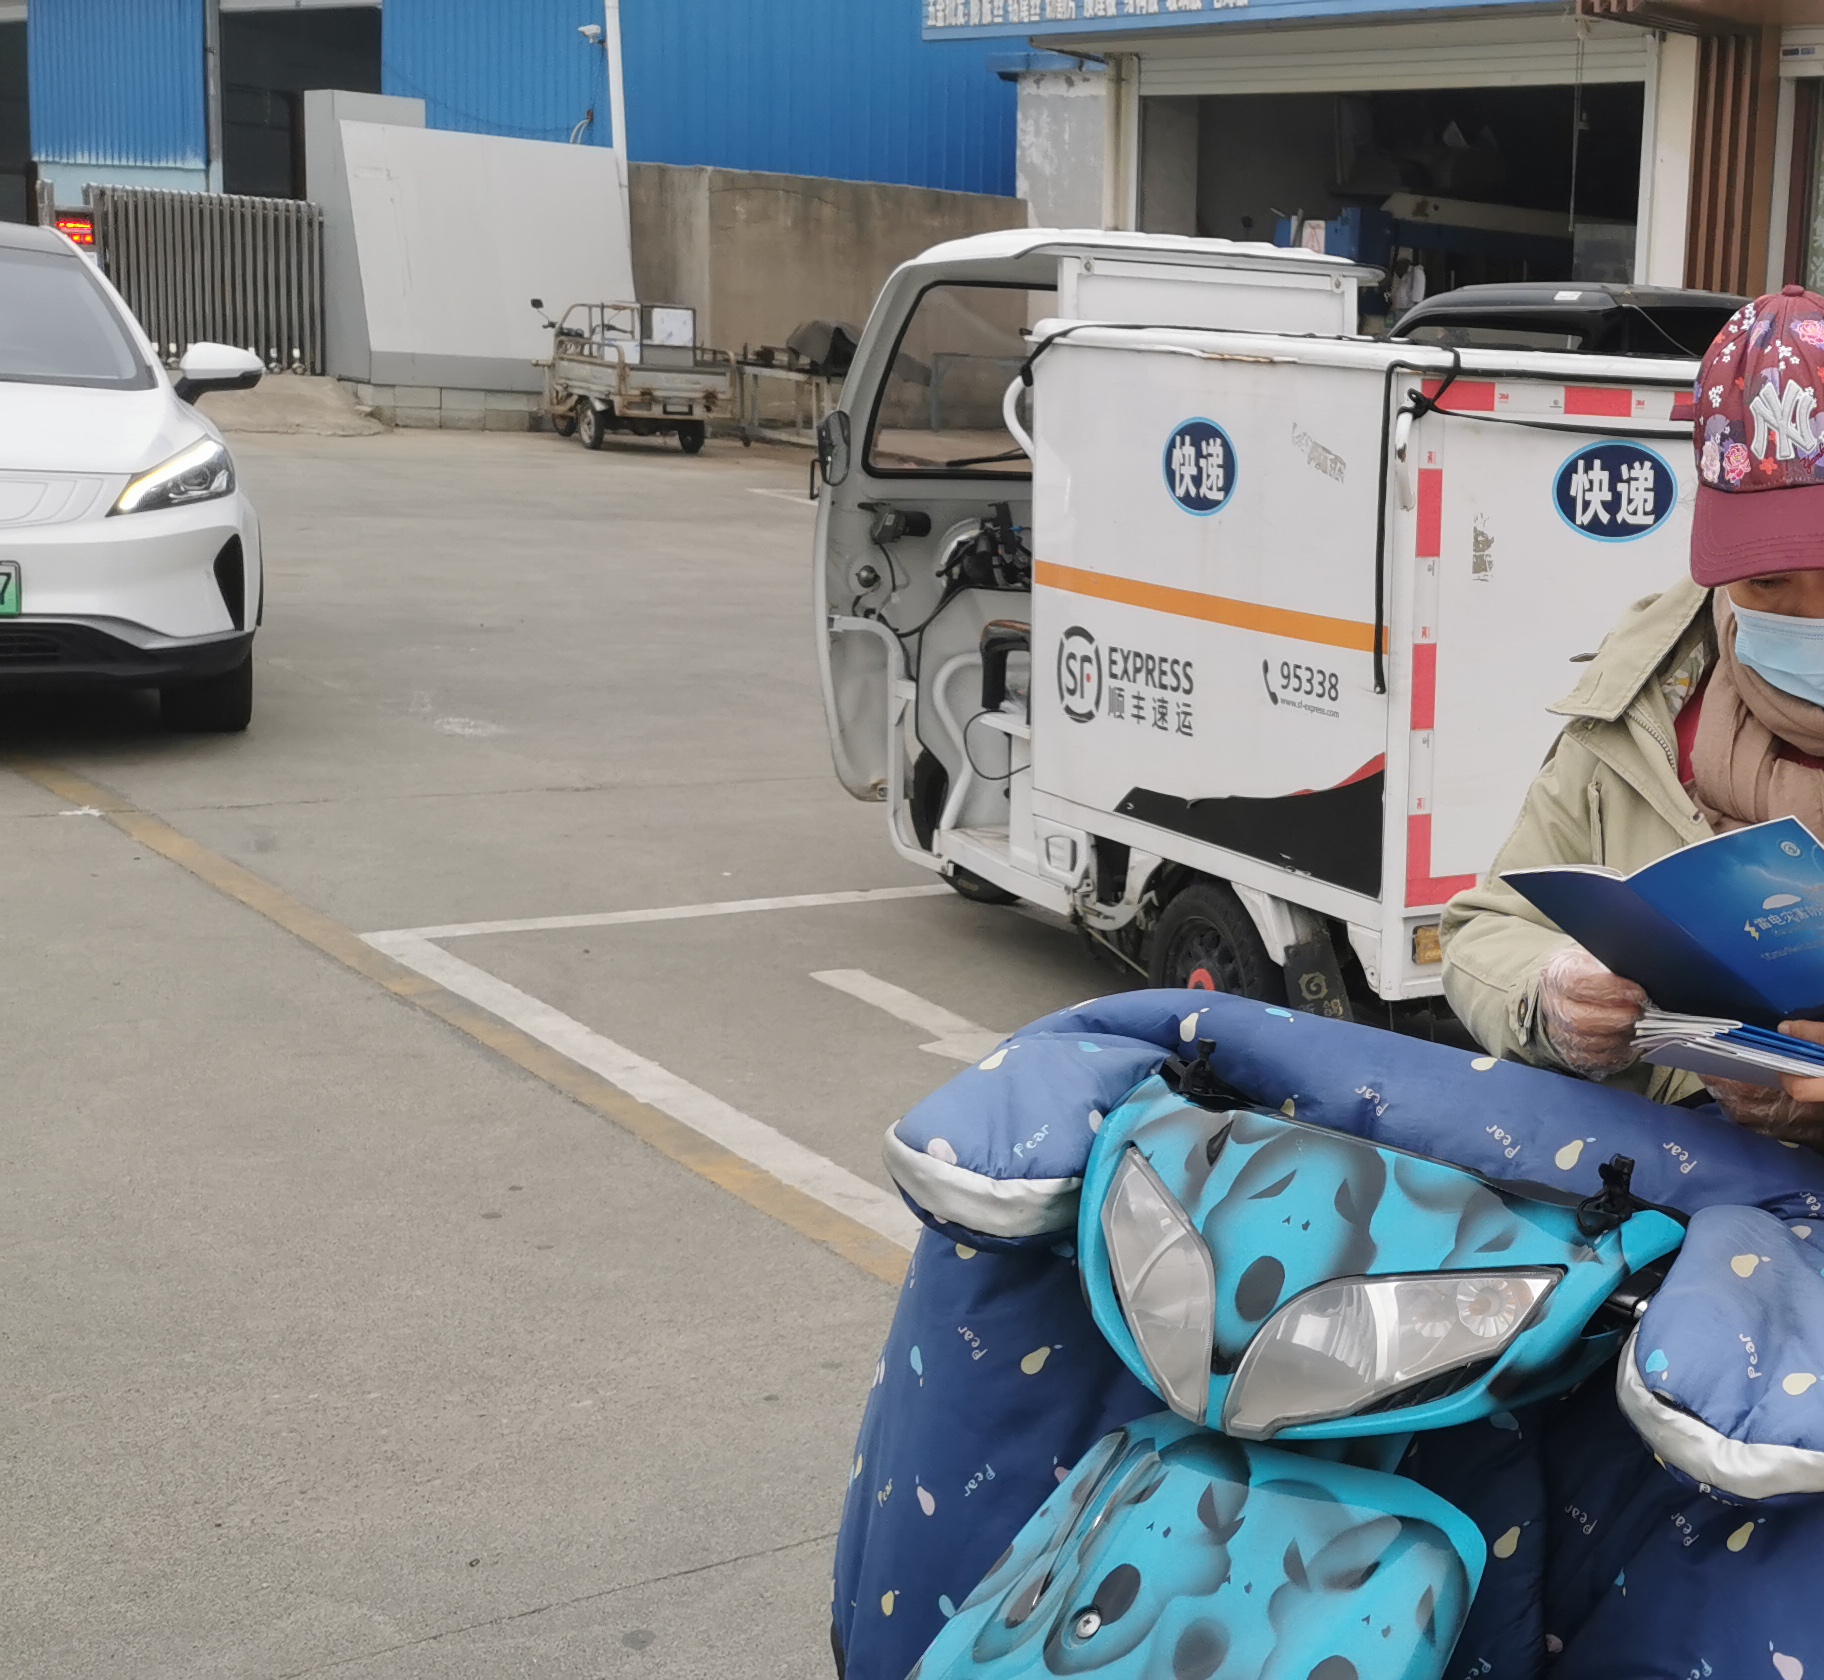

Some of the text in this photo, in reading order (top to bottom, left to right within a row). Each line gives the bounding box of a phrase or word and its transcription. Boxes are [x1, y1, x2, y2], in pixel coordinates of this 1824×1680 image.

[1750, 379, 1818, 460] NY
[1171, 434, 1225, 503] 快递
[1569, 458, 1657, 527] 快递
[1108, 646, 1194, 695] EXPRESS
[1280, 661, 1340, 701] 95338
[1106, 685, 1194, 738] 顺丰速运
[1279, 696, 1340, 719] www.sf-express.com
[1354, 1084, 1390, 1117] Pear
[1013, 1123, 1050, 1158] Pear
[1485, 1123, 1521, 1160] Pear
[1662, 1140, 1698, 1175] Pear
[956, 1324, 989, 1361] Pear
[1739, 1333, 1763, 1379] Pear
[964, 1463, 996, 1498] Pear
[1564, 1504, 1598, 1536] Pear
[1670, 1512, 1700, 1547] Pear
